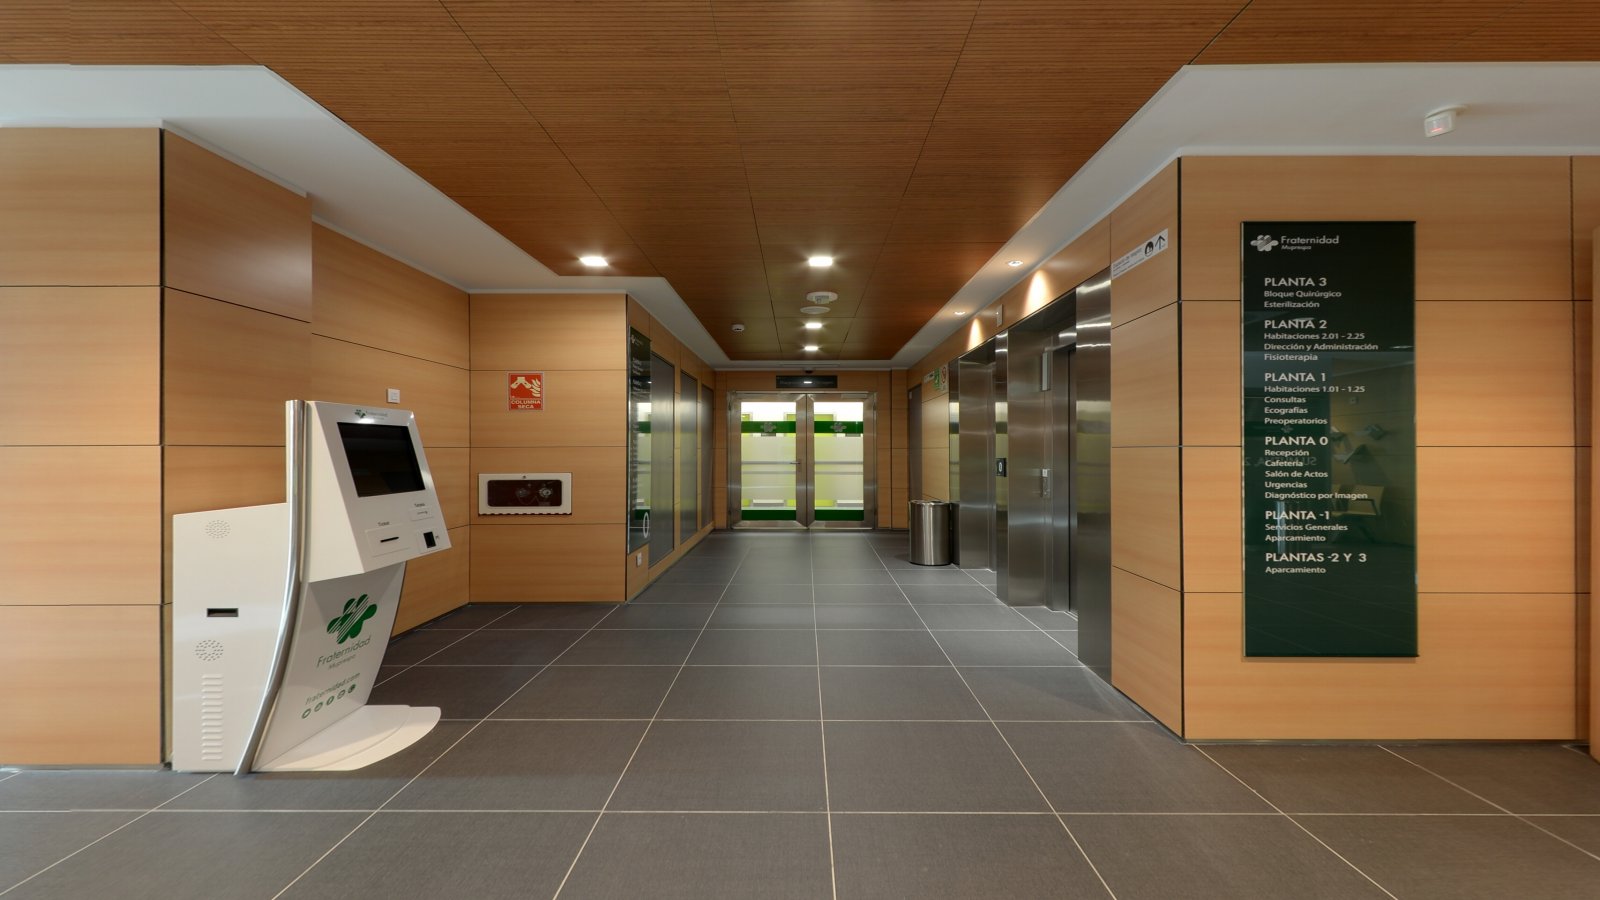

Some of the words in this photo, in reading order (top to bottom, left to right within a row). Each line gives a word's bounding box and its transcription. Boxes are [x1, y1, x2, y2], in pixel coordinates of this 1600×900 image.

[1281, 235, 1339, 245] Fraternidad
[1264, 277, 1315, 287] PLANTA
[1319, 277, 1327, 287] 3
[1264, 290, 1294, 298] Bloque
[1295, 290, 1342, 298] Quirúrgico
[1264, 300, 1320, 309] Esterilización
[1264, 319, 1315, 329] PLANTA
[1319, 319, 1327, 329] 2
[1264, 332, 1320, 340] Habitaciones
[1321, 332, 1339, 340] 2.01
[1347, 332, 1365, 340] 2.25
[1264, 343, 1305, 351] Dirección
[1313, 343, 1379, 351] Administración
[1264, 353, 1318, 362] Fisioterapia
[1264, 372, 1316, 382] PLANTA
[1321, 373, 1327, 382] 1
[1264, 385, 1321, 393] Habitaciones
[1322, 385, 1339, 393] 1.01
[1347, 385, 1366, 393] 1.25
[1264, 395, 1307, 403] Consultas
[1264, 406, 1309, 415] Ecografías
[1264, 417, 1328, 425] Preoperatorios
[1265, 436, 1317, 446] PLANTA
[1319, 436, 1329, 446] 0
[1265, 449, 1310, 458] Recepción
[1265, 459, 1304, 467] Cafetería
[1265, 470, 1289, 478] Salón
[1290, 470, 1303, 478] de
[1303, 470, 1329, 478] Actos
[1265, 481, 1308, 490] Urgencias
[1265, 491, 1317, 500] Diagnóstico
[1334, 491, 1369, 500] Imagen
[1265, 510, 1317, 520] PLANTA
[1319, 510, 1330, 520] -1
[1265, 523, 1304, 531] Servicios
[1304, 523, 1348, 531] Generales
[1265, 534, 1326, 543] Aparcamiento
[1265, 552, 1325, 562] PLANTAS
[1327, 552, 1340, 562] -2
[1343, 552, 1353, 562] Y
[1358, 552, 1367, 562] 3
[1265, 566, 1327, 575] Aparcamiento
[316, 635, 372, 669] Fraternidad
[305, 672, 361, 705] fraternidad.com
